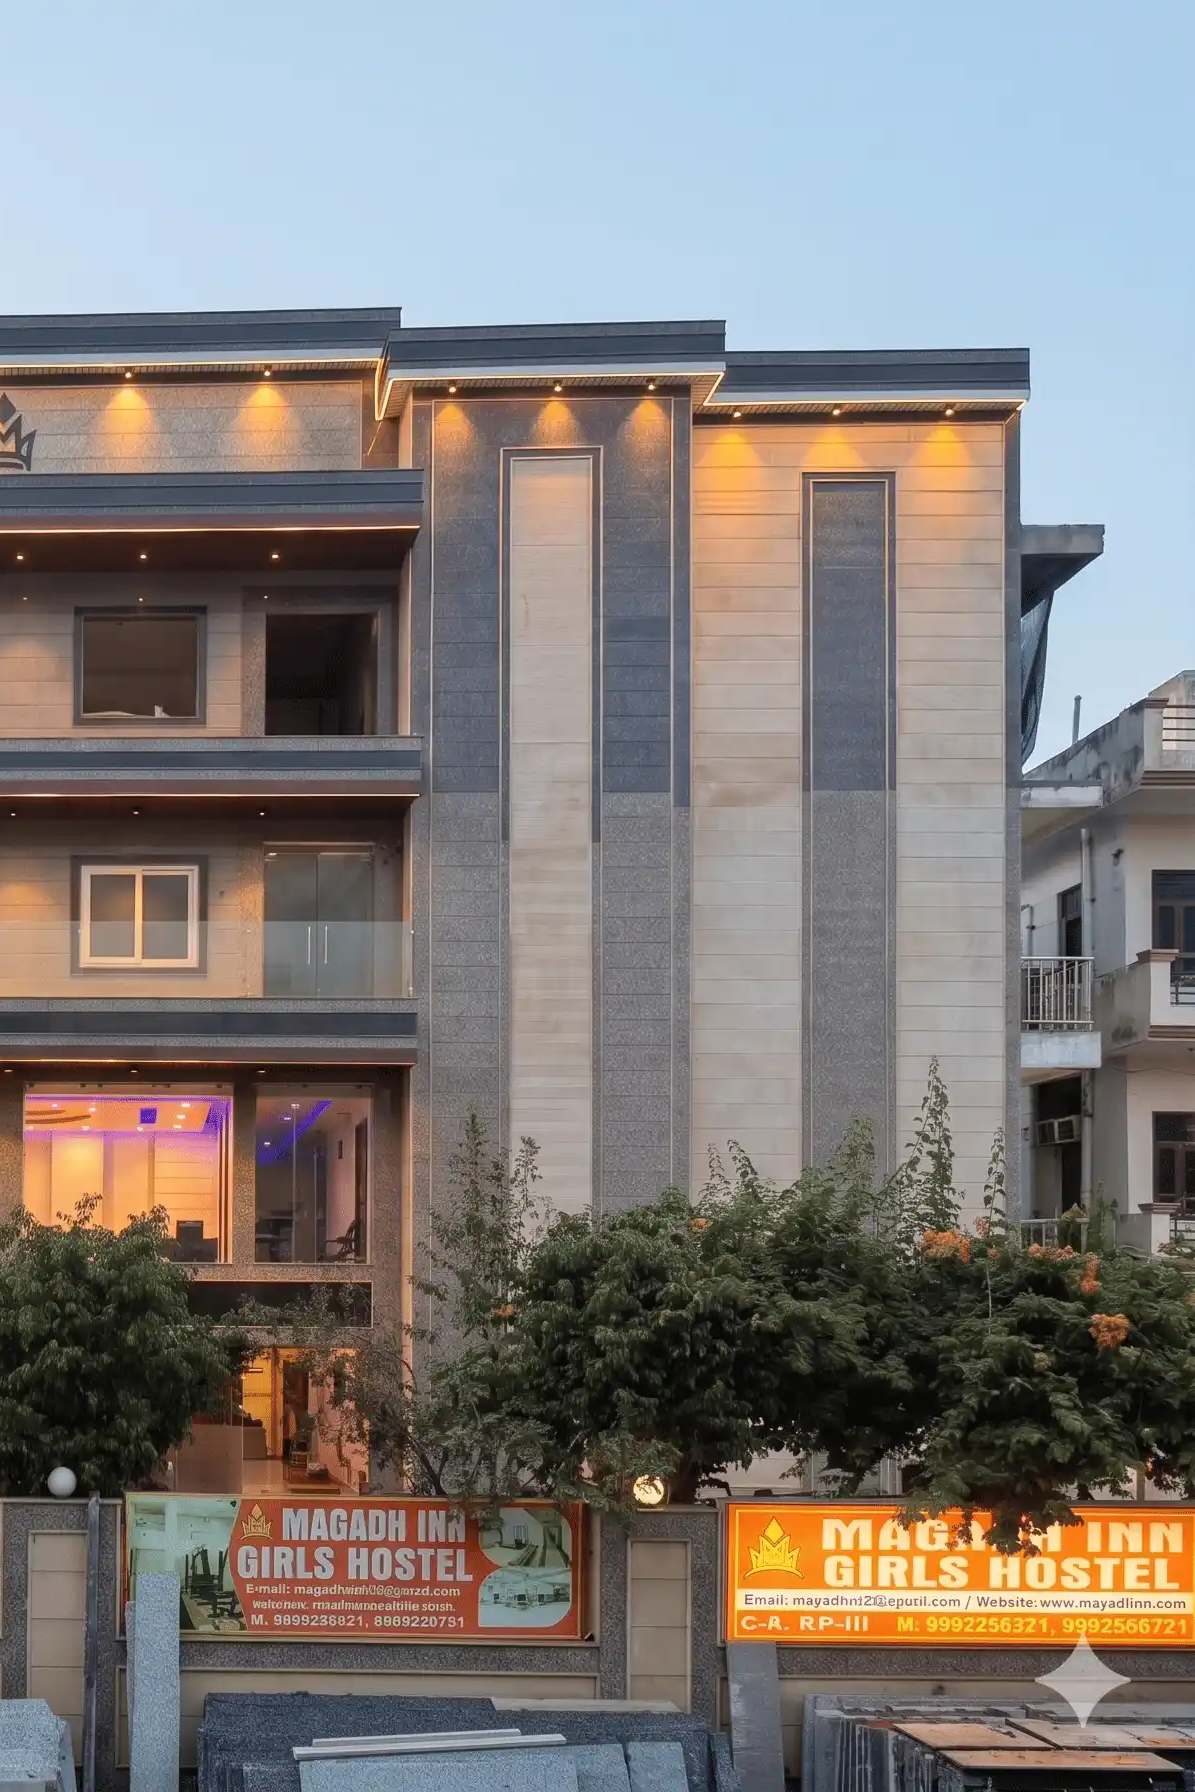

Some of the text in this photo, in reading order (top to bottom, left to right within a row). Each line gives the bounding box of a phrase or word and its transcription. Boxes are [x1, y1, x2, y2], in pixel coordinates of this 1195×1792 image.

[282, 1508, 465, 1543] MAGADH INN
[822, 1518, 1184, 1553] MAGAH INN
[237, 1545, 474, 1581] GIRLS HOSTEL
[823, 1555, 1180, 1590] GIRLS HOSTEL
[744, 1593, 788, 1605] Email:
